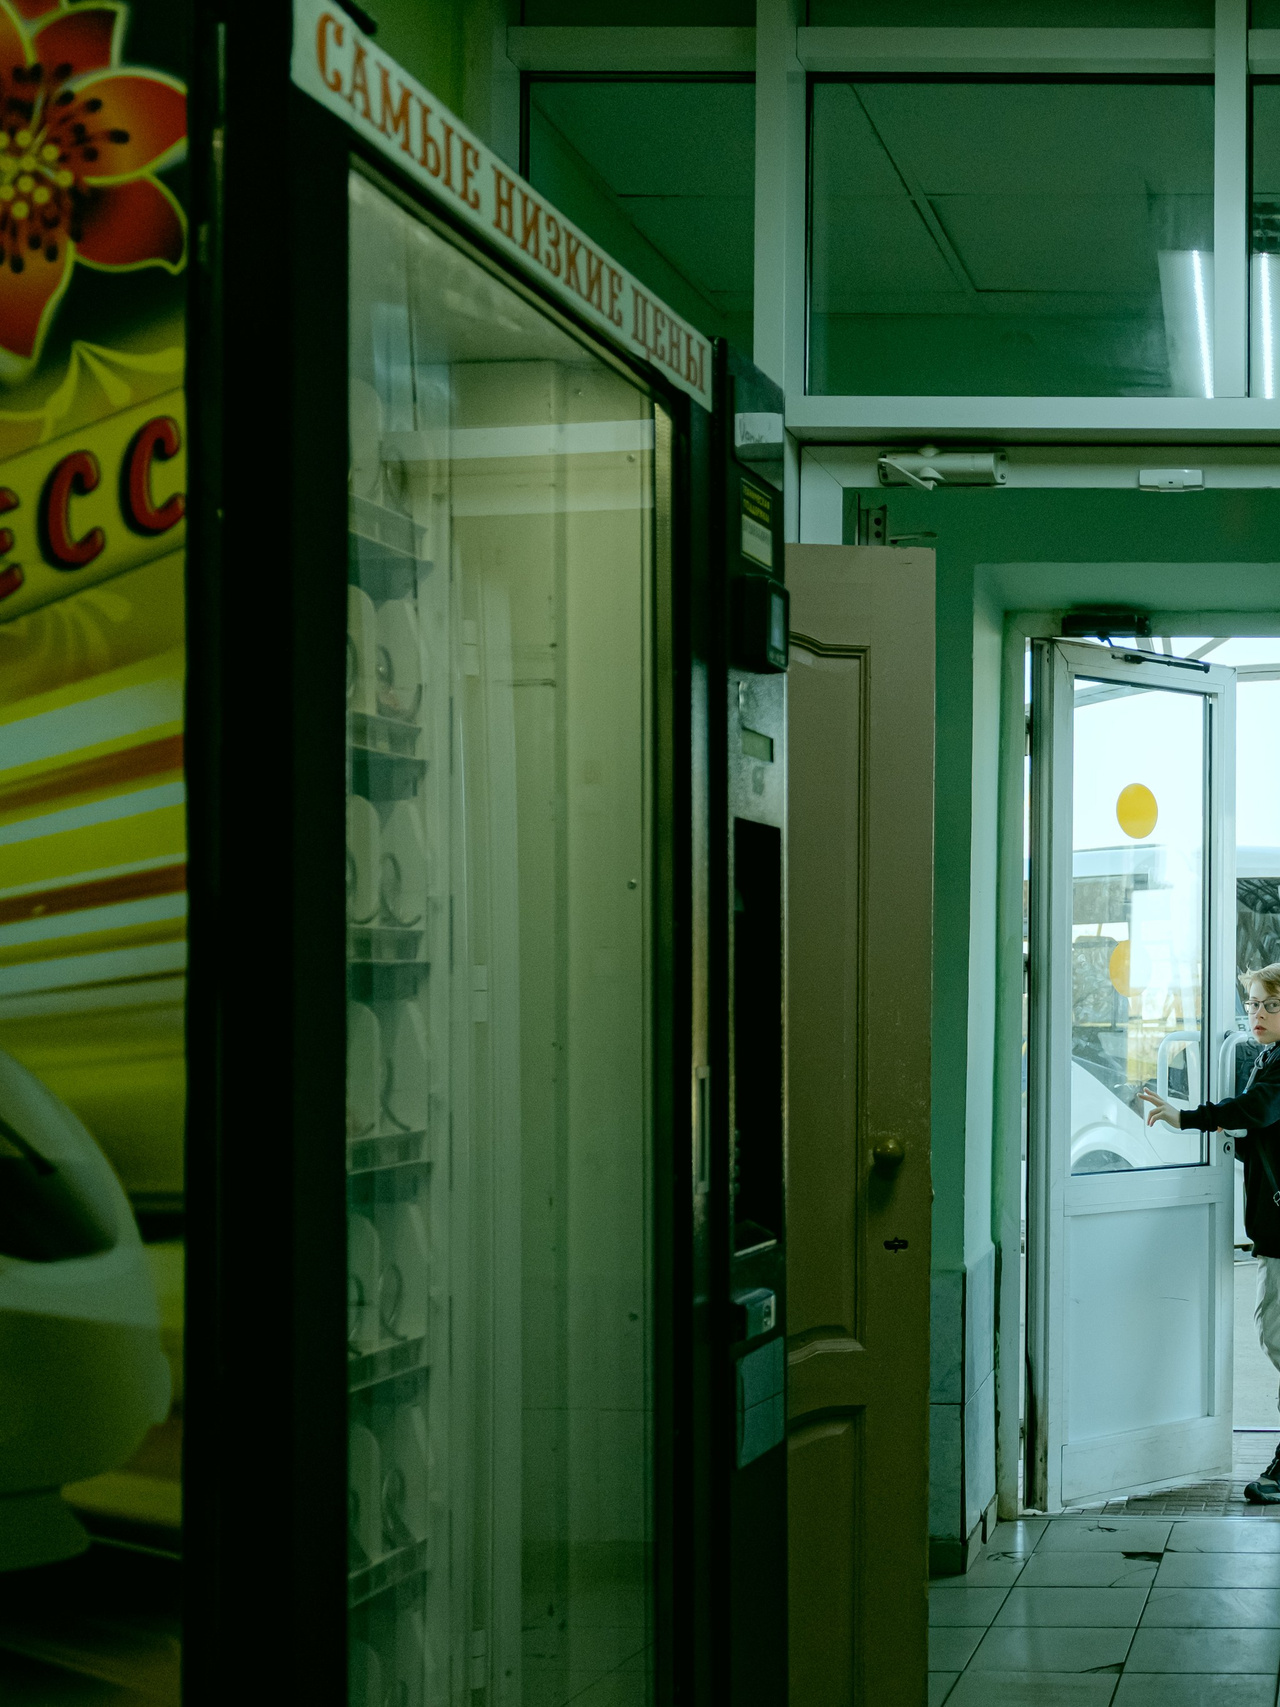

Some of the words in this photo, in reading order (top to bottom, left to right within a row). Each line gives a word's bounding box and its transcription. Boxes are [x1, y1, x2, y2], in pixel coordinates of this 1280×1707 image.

[315, 12, 480, 211] САМЫЕ
[490, 164, 624, 328] НИЗКИЕ
[631, 285, 707, 395] ЦЕНЫ
